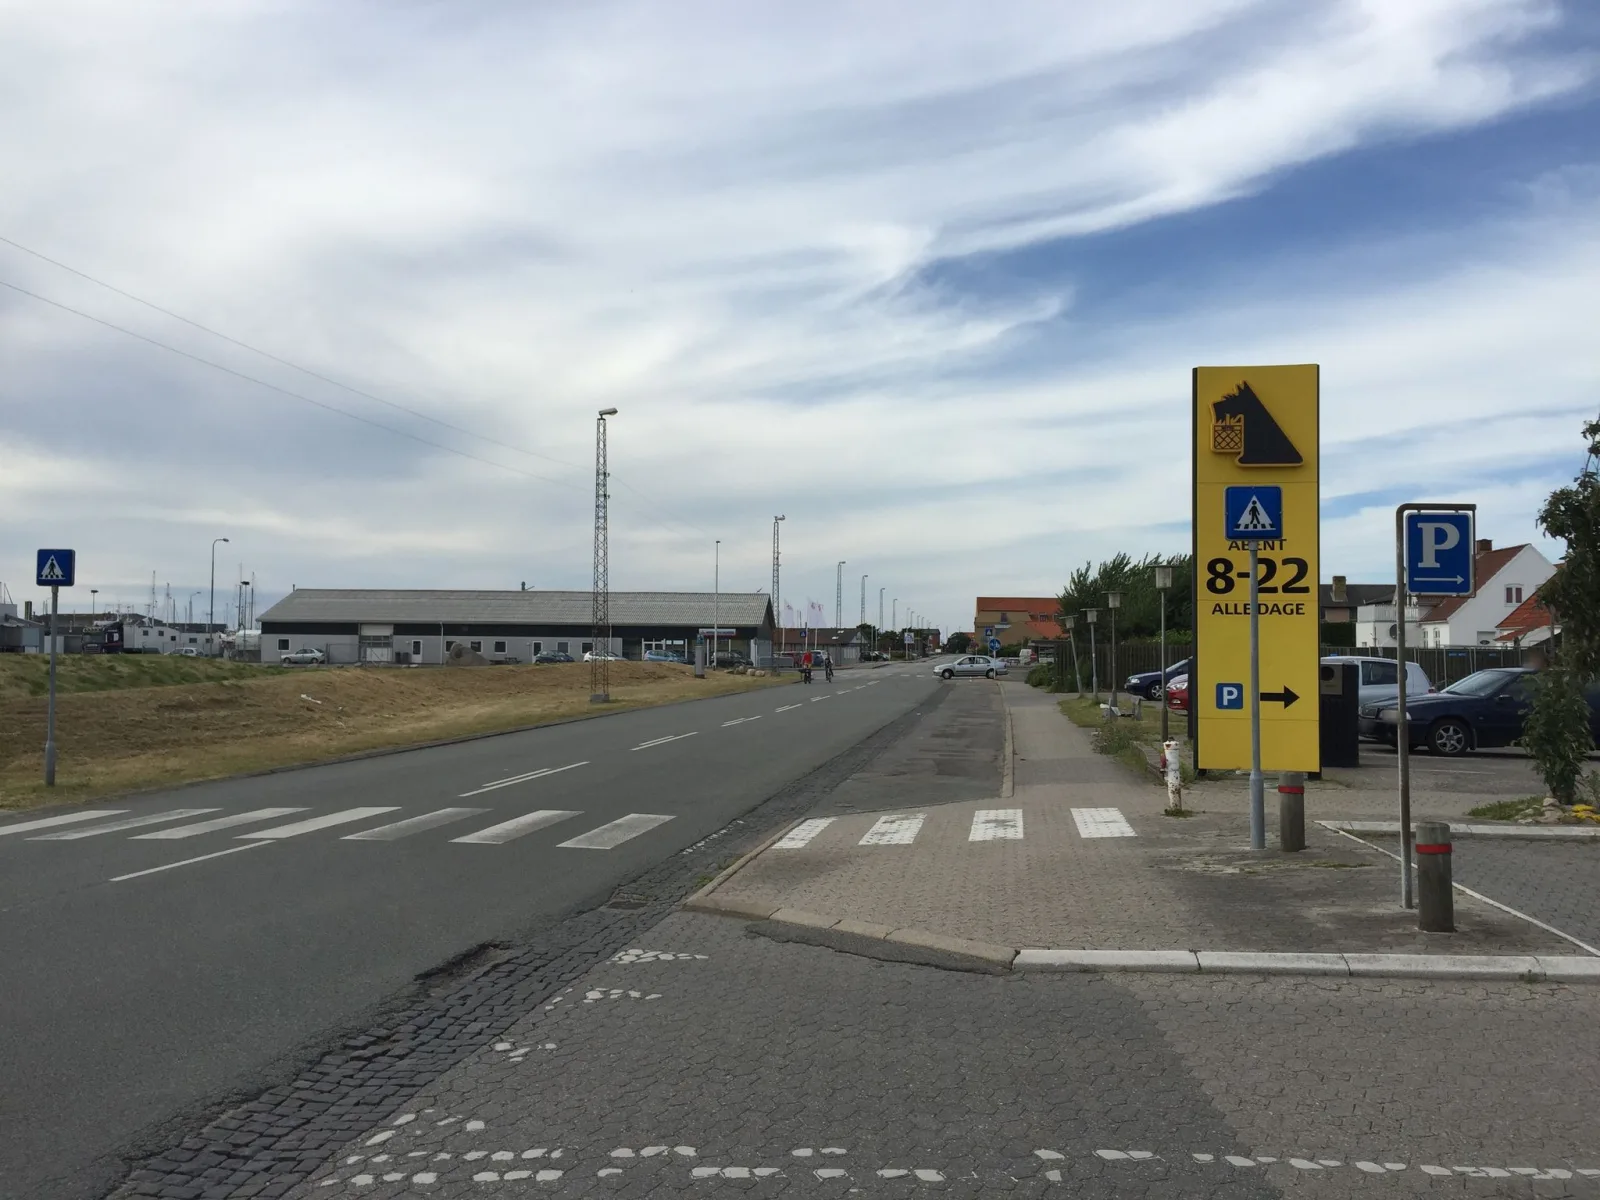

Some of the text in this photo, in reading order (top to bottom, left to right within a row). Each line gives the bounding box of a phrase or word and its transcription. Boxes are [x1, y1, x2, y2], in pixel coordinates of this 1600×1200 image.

[1417, 522, 1460, 568] P
[1206, 557, 1310, 594] 8-22
[1212, 603, 1305, 615] ALLE DAGE
[1223, 687, 1238, 706] P
